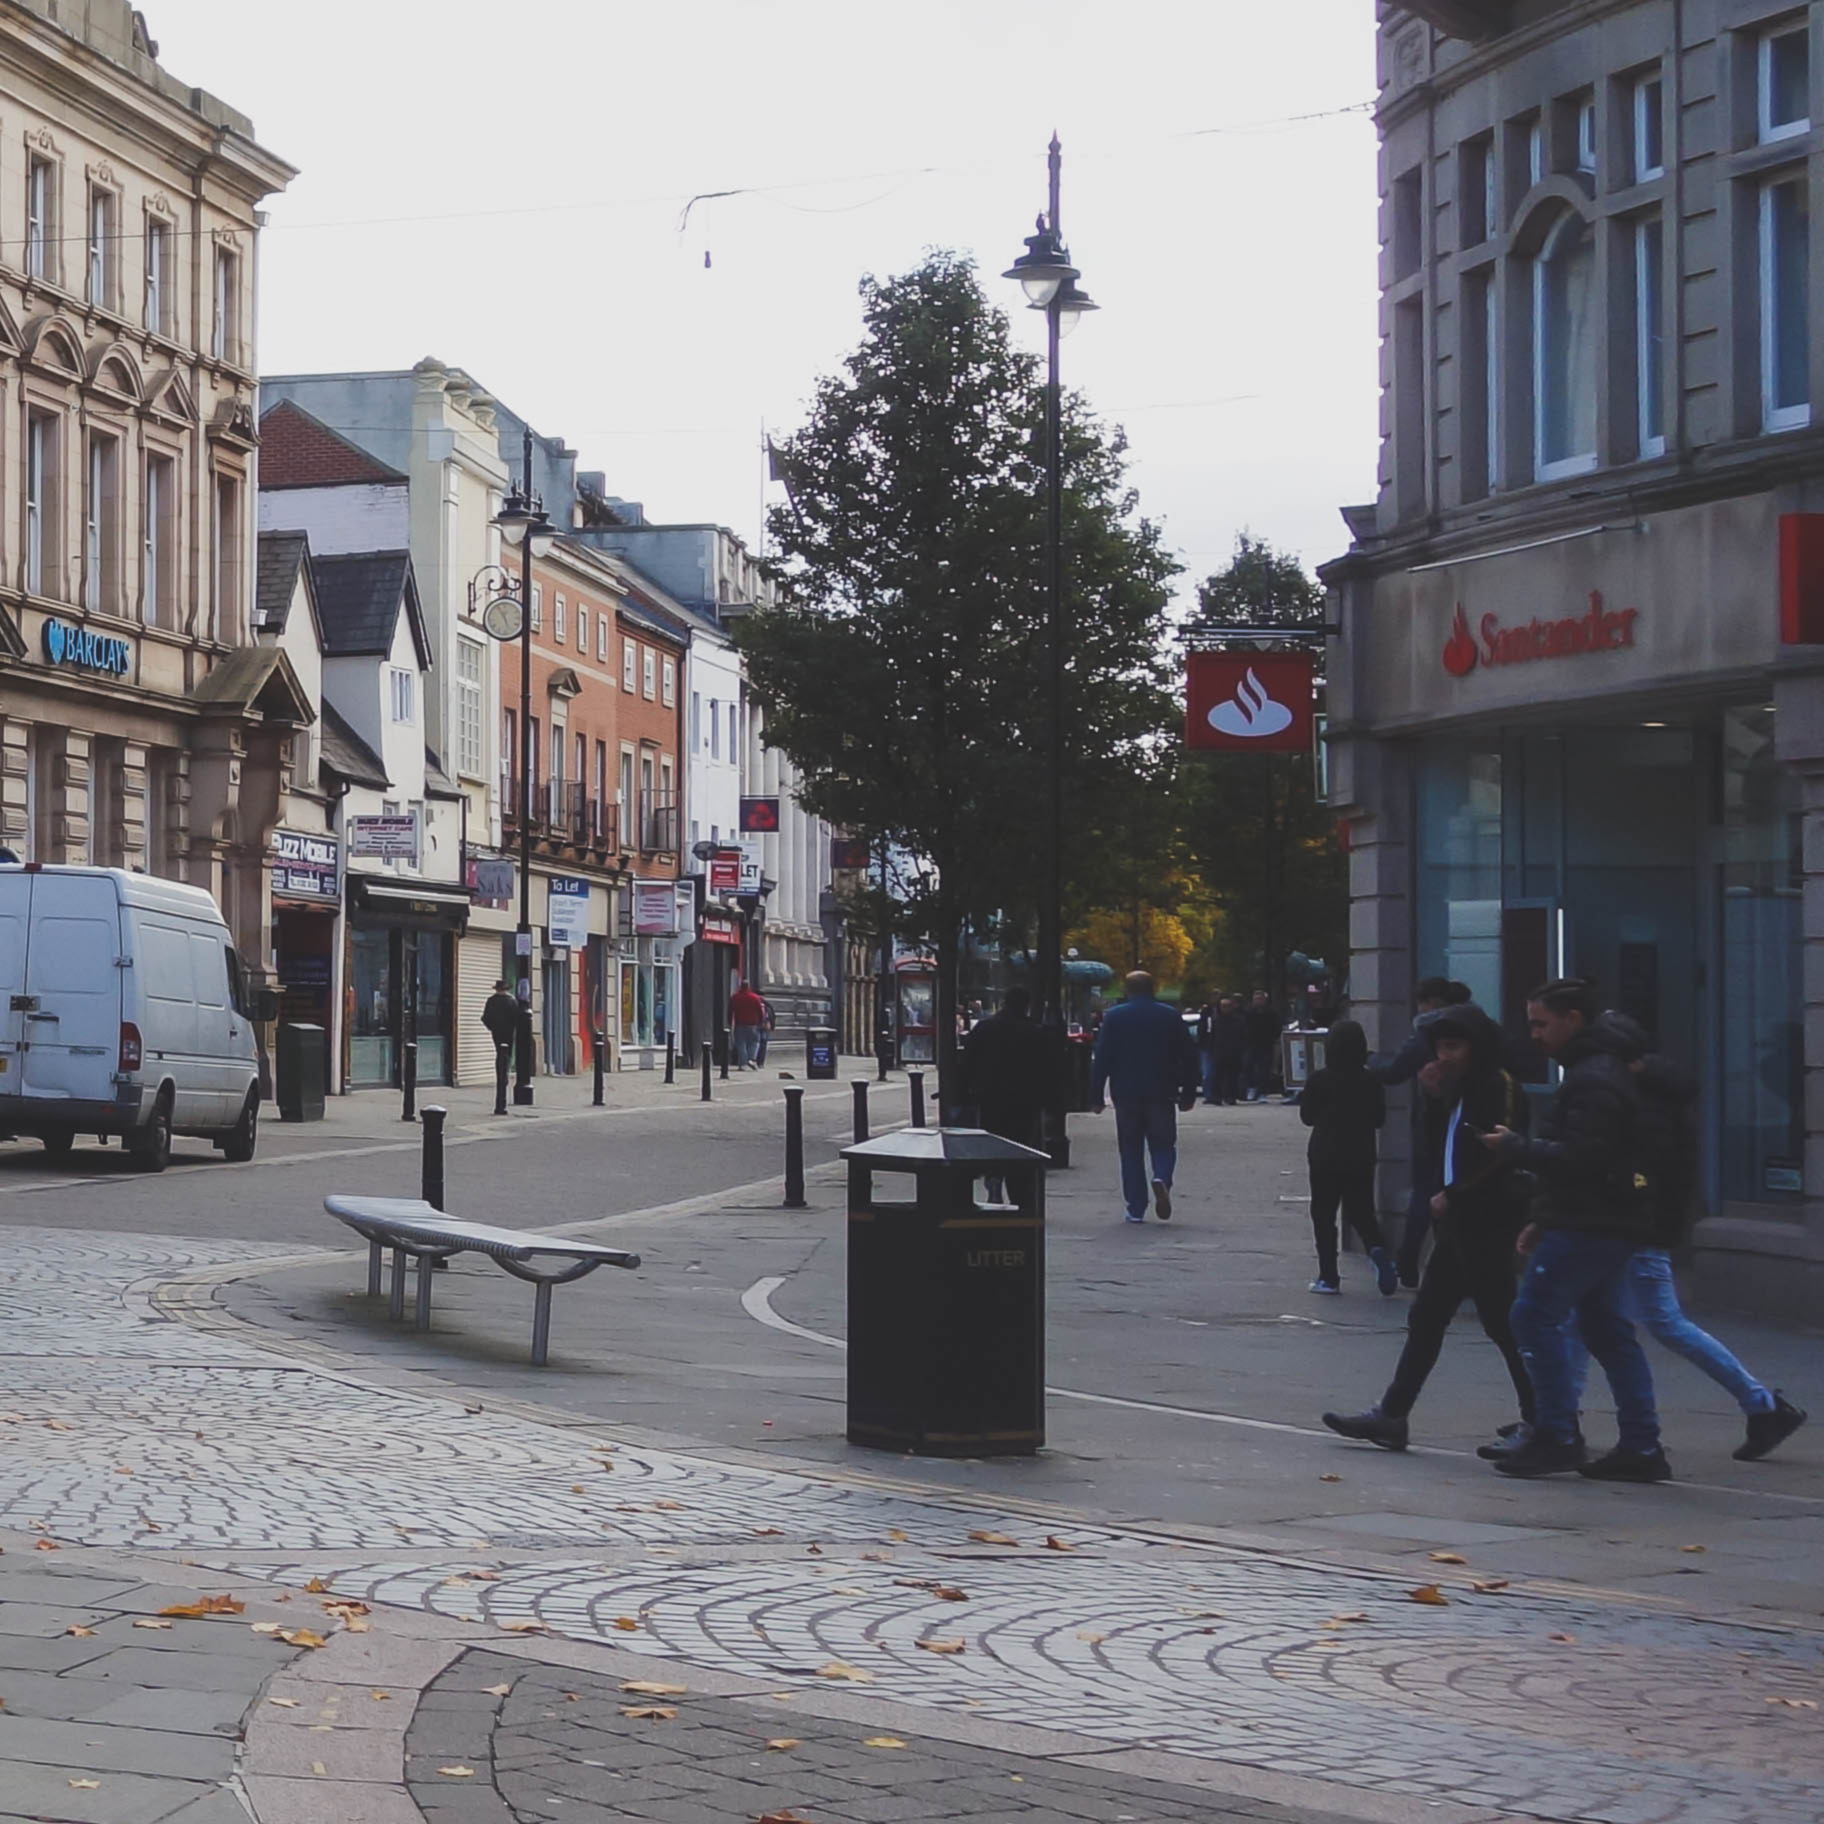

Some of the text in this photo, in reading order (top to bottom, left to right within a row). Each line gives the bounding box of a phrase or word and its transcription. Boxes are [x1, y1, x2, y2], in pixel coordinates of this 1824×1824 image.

[1480, 589, 1638, 669] Santander
[66, 628, 129, 674] BARCLAYS
[552, 879, 579, 892] To Let
[967, 1249, 1025, 1267] LITTER
